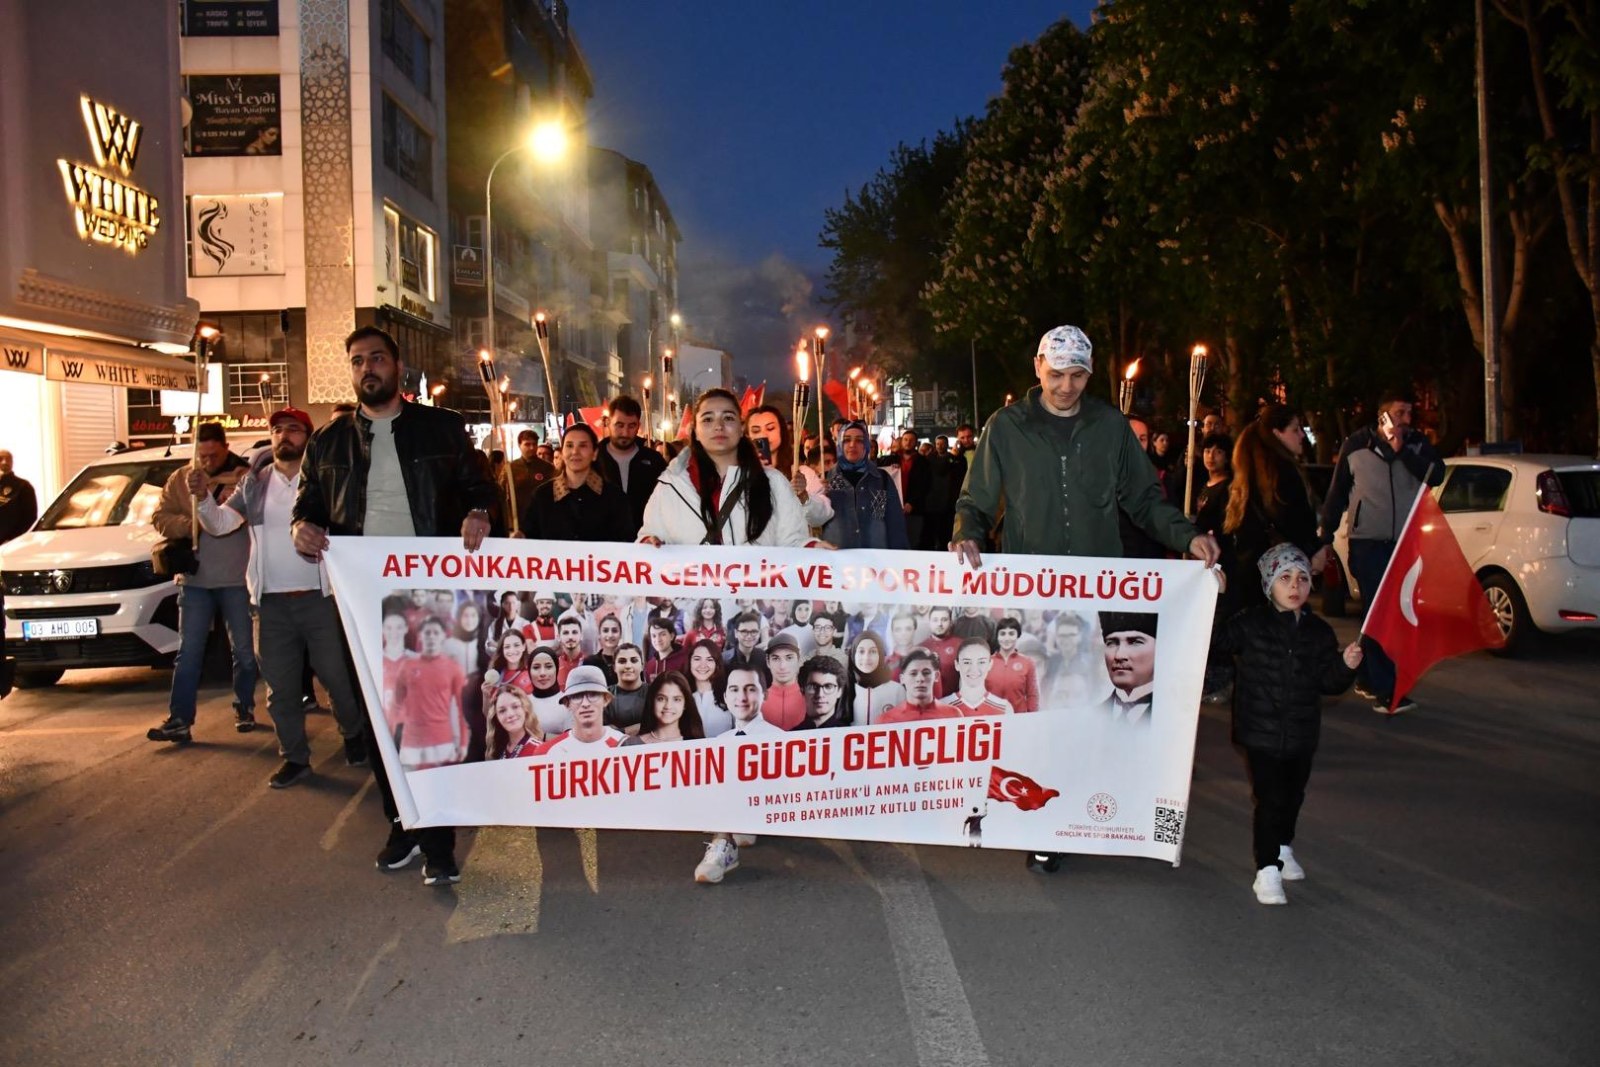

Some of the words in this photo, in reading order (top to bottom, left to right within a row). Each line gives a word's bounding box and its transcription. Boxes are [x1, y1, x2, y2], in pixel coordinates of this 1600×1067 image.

[196, 90, 231, 105] Miss
[234, 91, 276, 106] Leydi
[57, 159, 160, 229] WHITE
[75, 206, 148, 249] WEDDING
[95, 364, 139, 384] WHITE
[145, 373, 178, 388] WEDDING
[382, 554, 652, 585] AFYONKARAHİSAR
[660, 559, 788, 593] GENÇLİK
[799, 564, 833, 589] VE
[841, 566, 920, 593] SPOR
[928, 563, 953, 594] İL
[961, 567, 1163, 601] MÜDÜRLÜĞÜ
[31, 623, 43, 636] 03
[51, 622, 69, 635] AHD
[75, 621, 95, 633] 005
[737, 737, 836, 781] GÜCÜ,
[842, 719, 1002, 771] GENÇLİĞİ
[748, 795, 760, 807] 19
[765, 792, 801, 806] MAYIS
[806, 785, 871, 802] ATATÜRK'Ü
[876, 783, 909, 796] ANMA
[914, 777, 963, 793] GENÇLİK
[968, 776, 983, 788] VE
[766, 811, 796, 824] SPOR
[801, 804, 875, 821] BAYRAMIMIZ
[880, 801, 916, 814] KUTLU
[922, 797, 964, 811] OLSUN!
[1055, 830, 1082, 838] GENÇLİK
[1111, 833, 1145, 841] BAKANLIĞI
